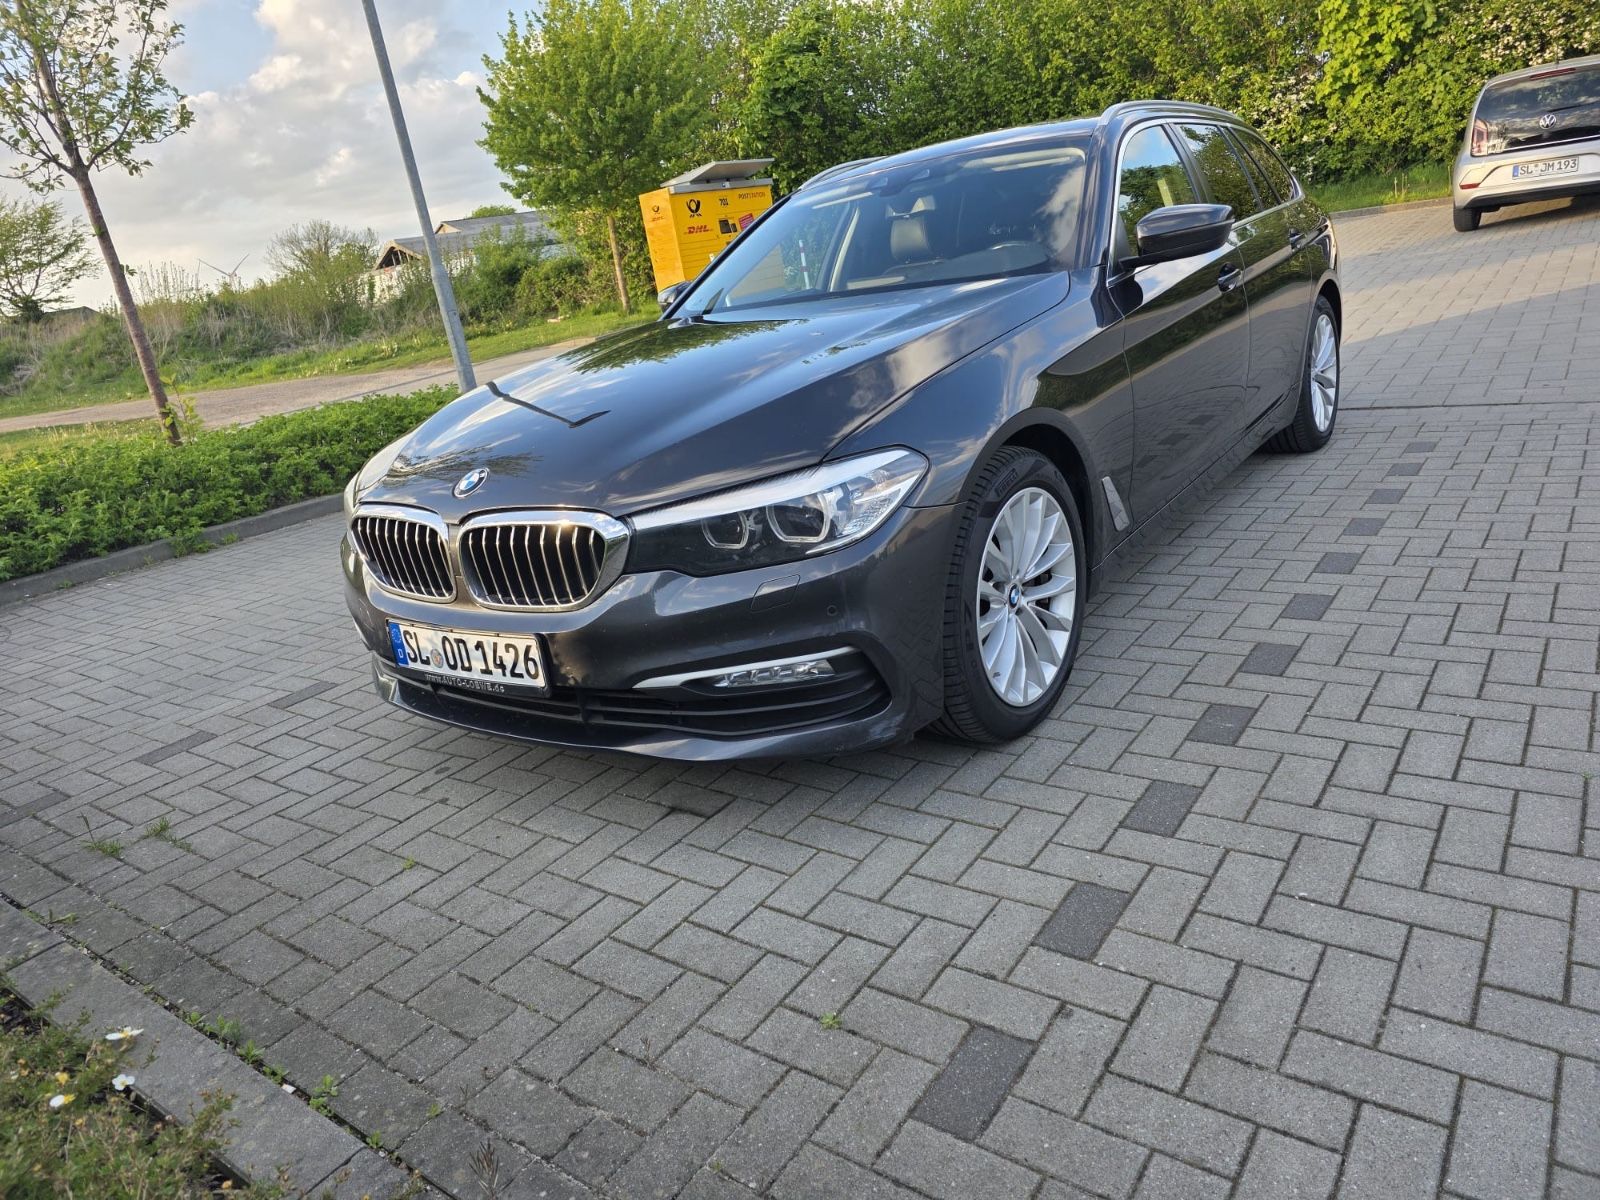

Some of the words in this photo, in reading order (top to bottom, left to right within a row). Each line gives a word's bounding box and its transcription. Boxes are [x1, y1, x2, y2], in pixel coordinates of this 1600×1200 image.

[1519, 165, 1533, 175] SL
[1540, 162, 1555, 173] JM
[1556, 159, 1577, 171] 193
[687, 224, 710, 235] DHL
[402, 629, 431, 666] SL
[441, 635, 473, 673] OD
[474, 640, 540, 680] 1426
